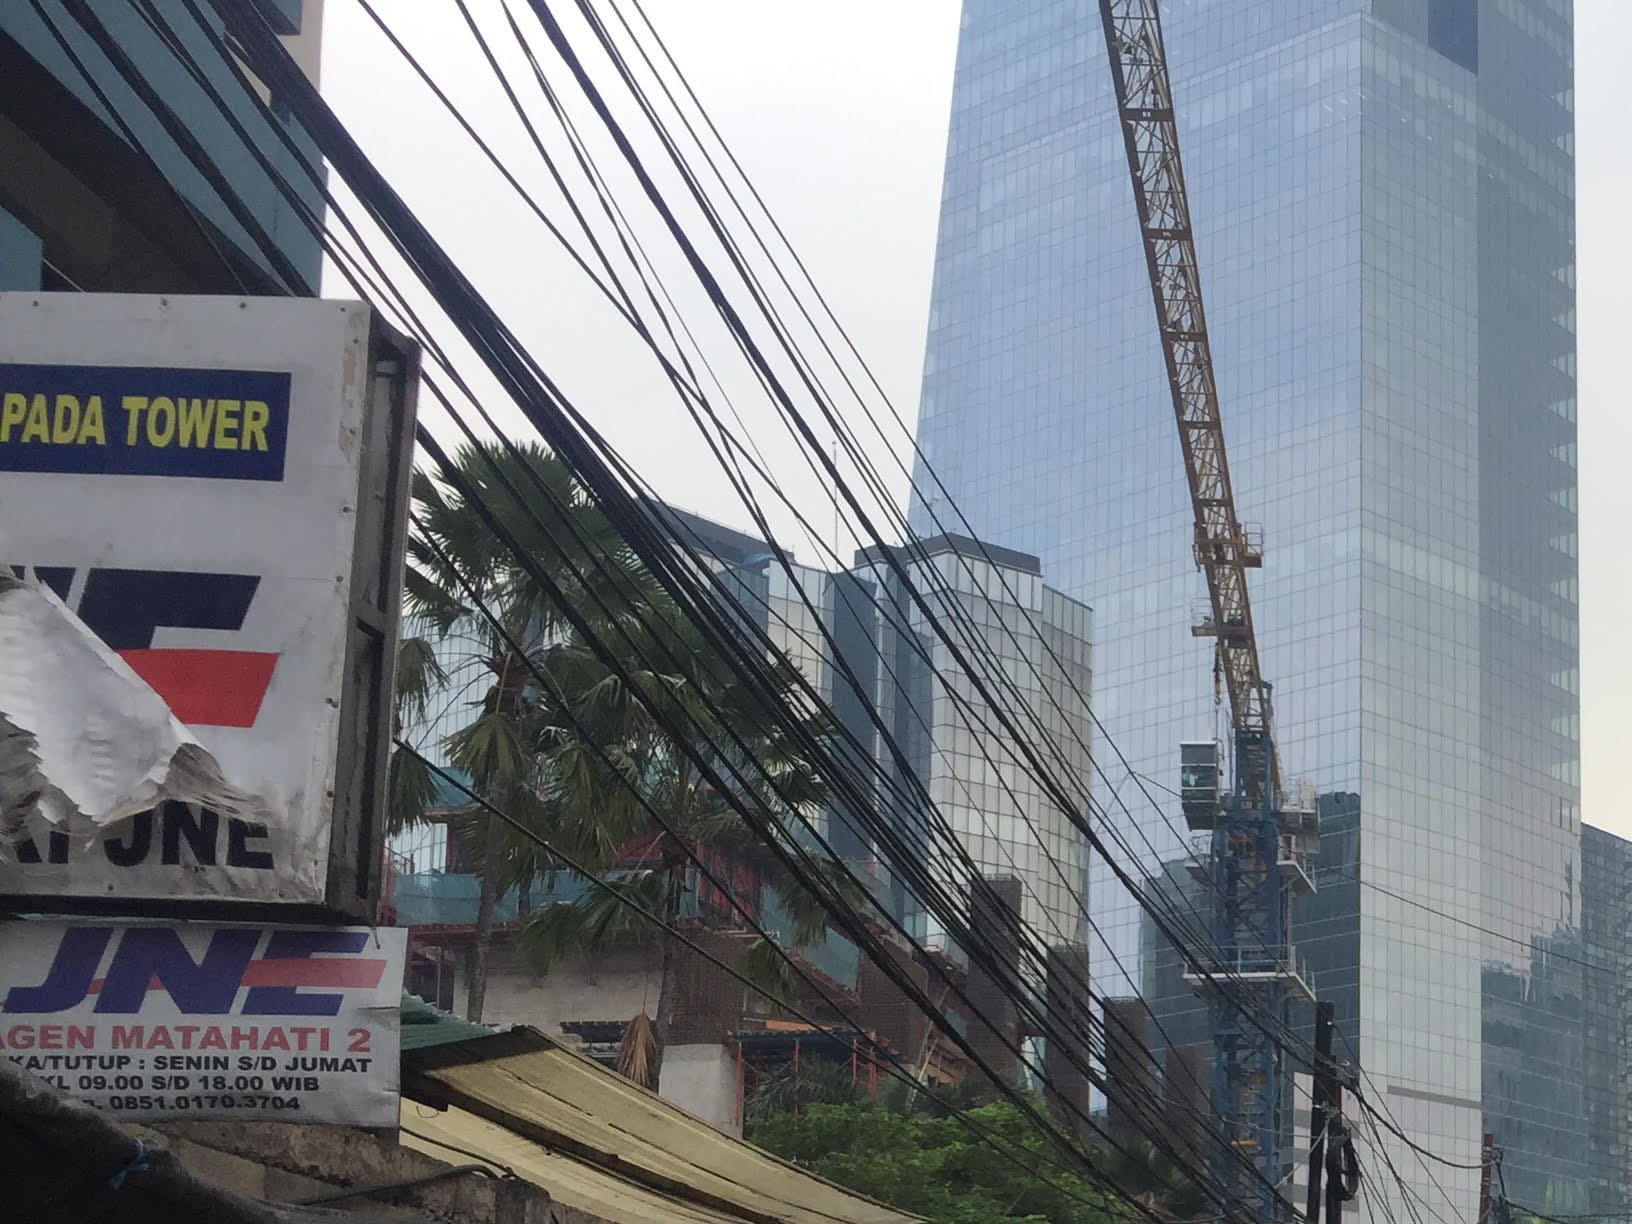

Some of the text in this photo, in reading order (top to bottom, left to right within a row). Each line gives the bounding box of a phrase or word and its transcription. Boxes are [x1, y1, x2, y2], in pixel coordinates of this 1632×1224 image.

[122, 396, 270, 452] TOWER
[104, 800, 274, 869] JNE
[2, 926, 387, 1016] JNE
[0, 1024, 372, 1053] GEN MATAHATI 2
[78, 1074, 144, 1092] 09.00
[151, 1075, 191, 1092] S/D
[199, 1075, 264, 1092] 18.00
[272, 1076, 320, 1092] WIB
[153, 1055, 230, 1072] SENIN
[238, 1056, 278, 1072] S/D
[285, 1056, 372, 1073] JUMAT
